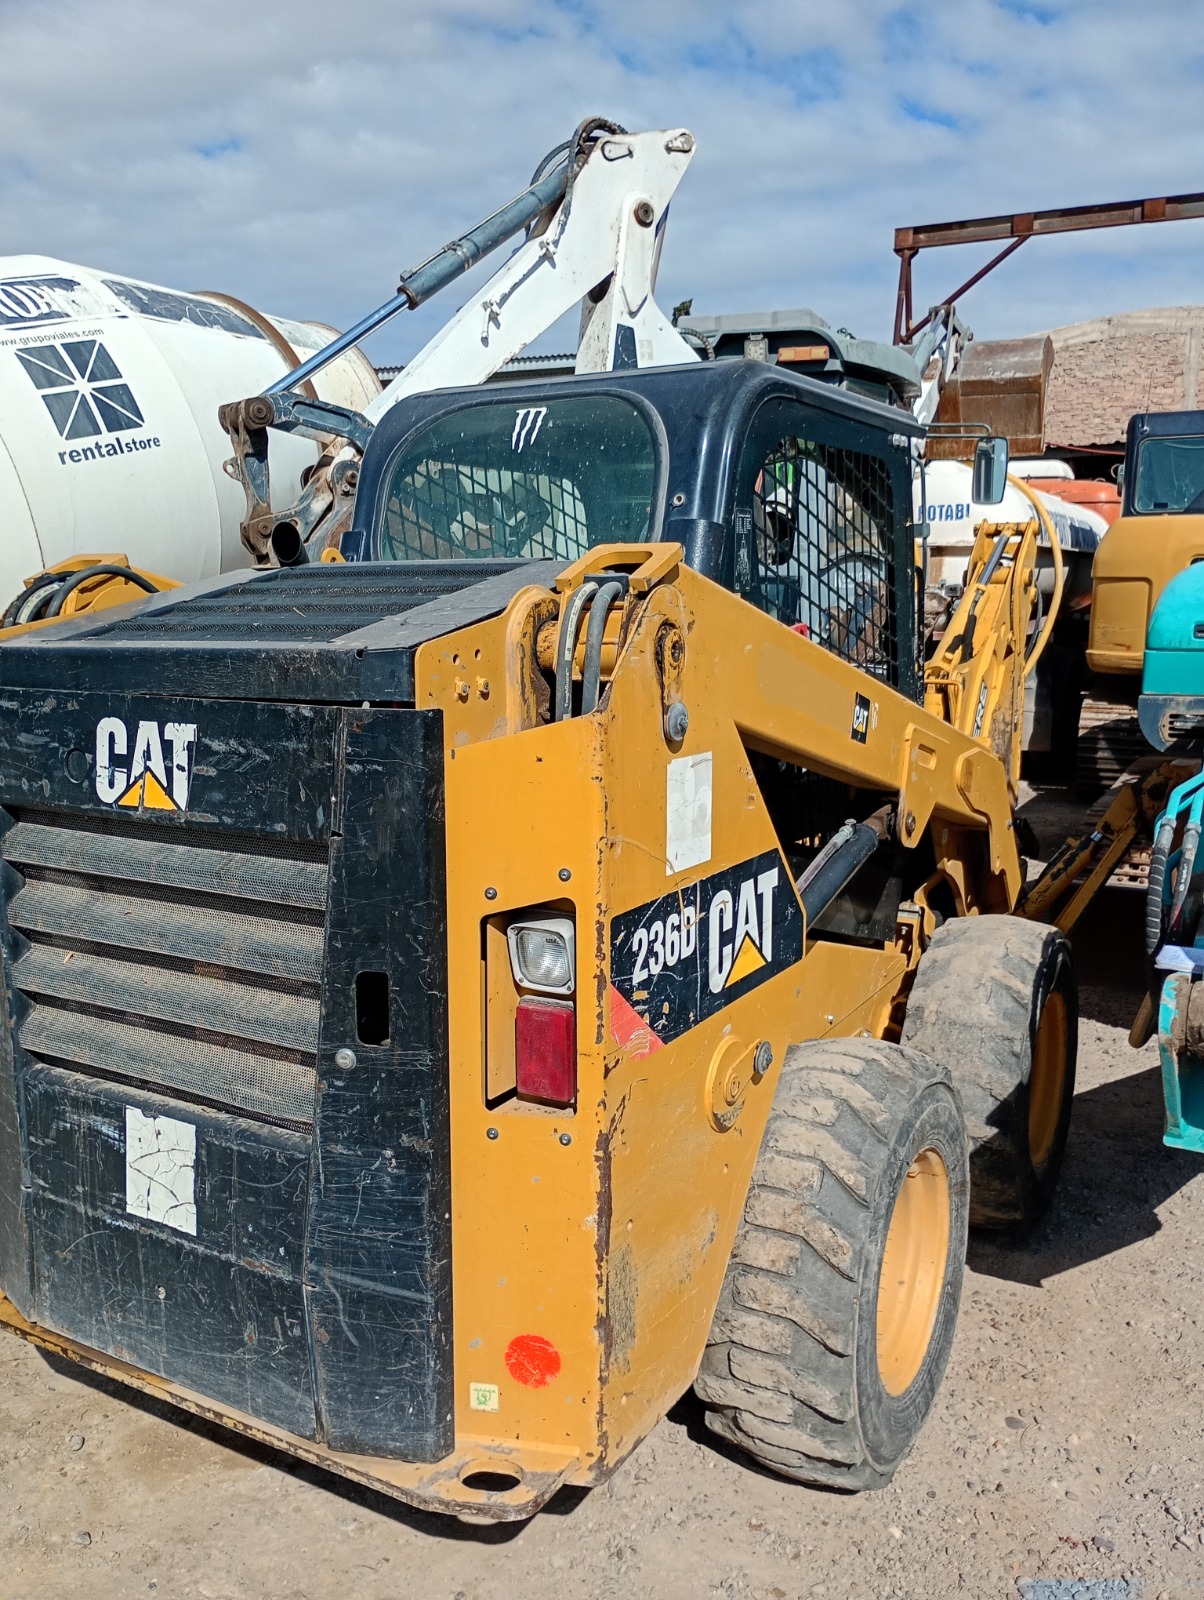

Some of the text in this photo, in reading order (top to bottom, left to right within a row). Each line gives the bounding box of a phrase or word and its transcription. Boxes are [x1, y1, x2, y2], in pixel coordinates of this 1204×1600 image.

[96, 716, 198, 812] CAT
[853, 704, 869, 734] CAT
[631, 867, 779, 994] 236D CAT
